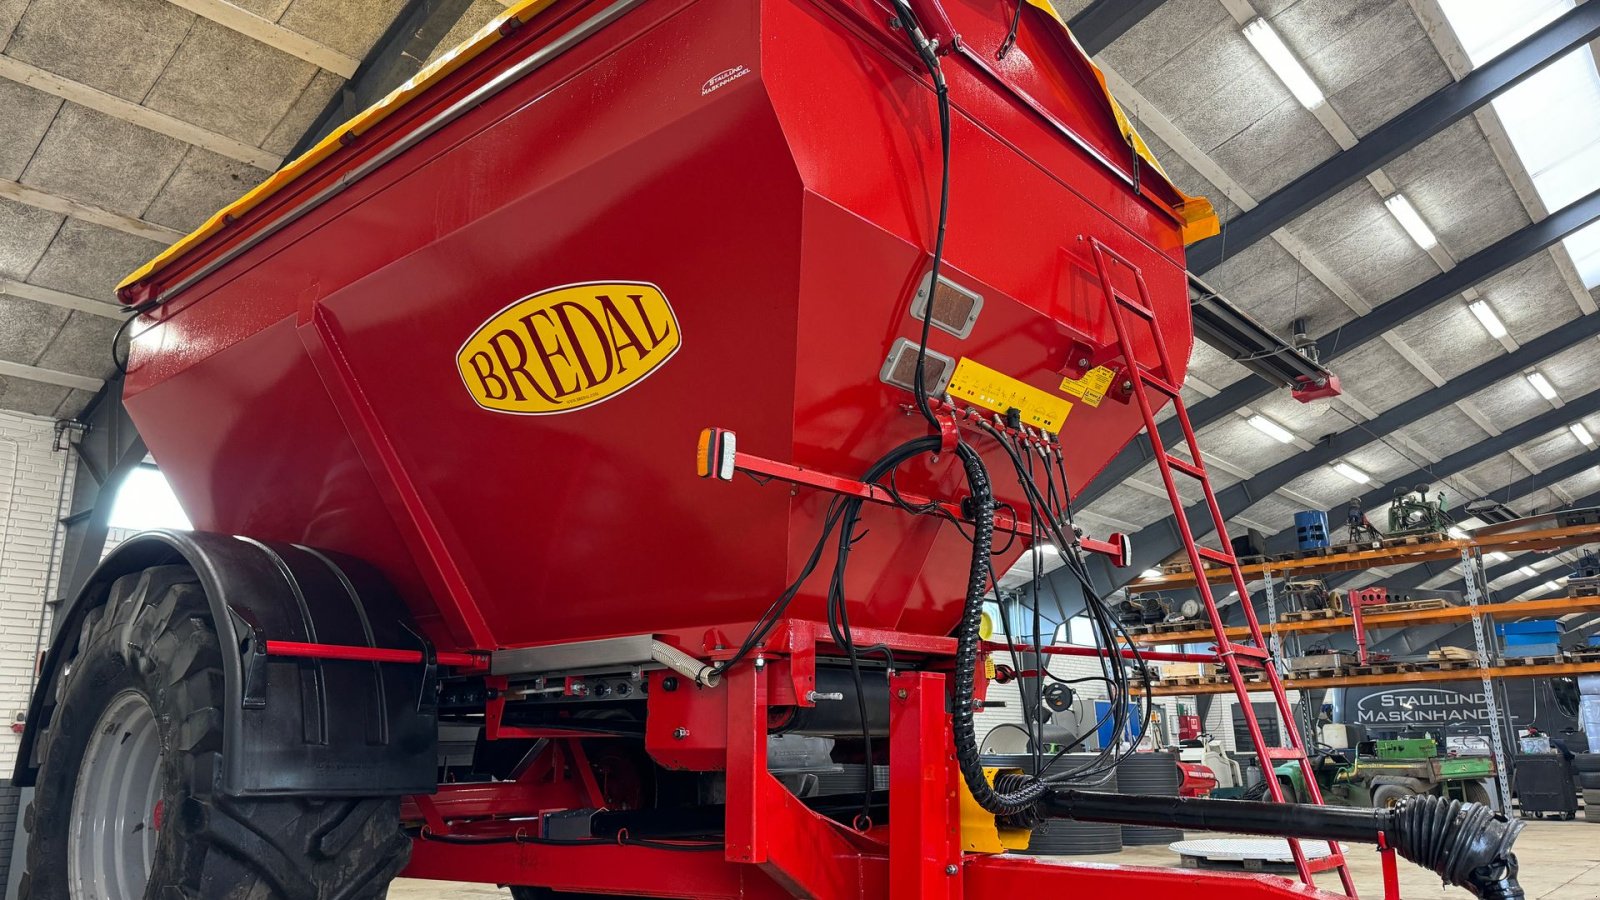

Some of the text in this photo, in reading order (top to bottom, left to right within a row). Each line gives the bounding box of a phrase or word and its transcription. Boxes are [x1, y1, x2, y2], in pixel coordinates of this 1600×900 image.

[702, 68, 751, 96] MASKINHANDEL
[709, 65, 743, 86] STAULUND
[469, 295, 670, 405] BREDAL
[1381, 693, 1487, 707] STAULUND
